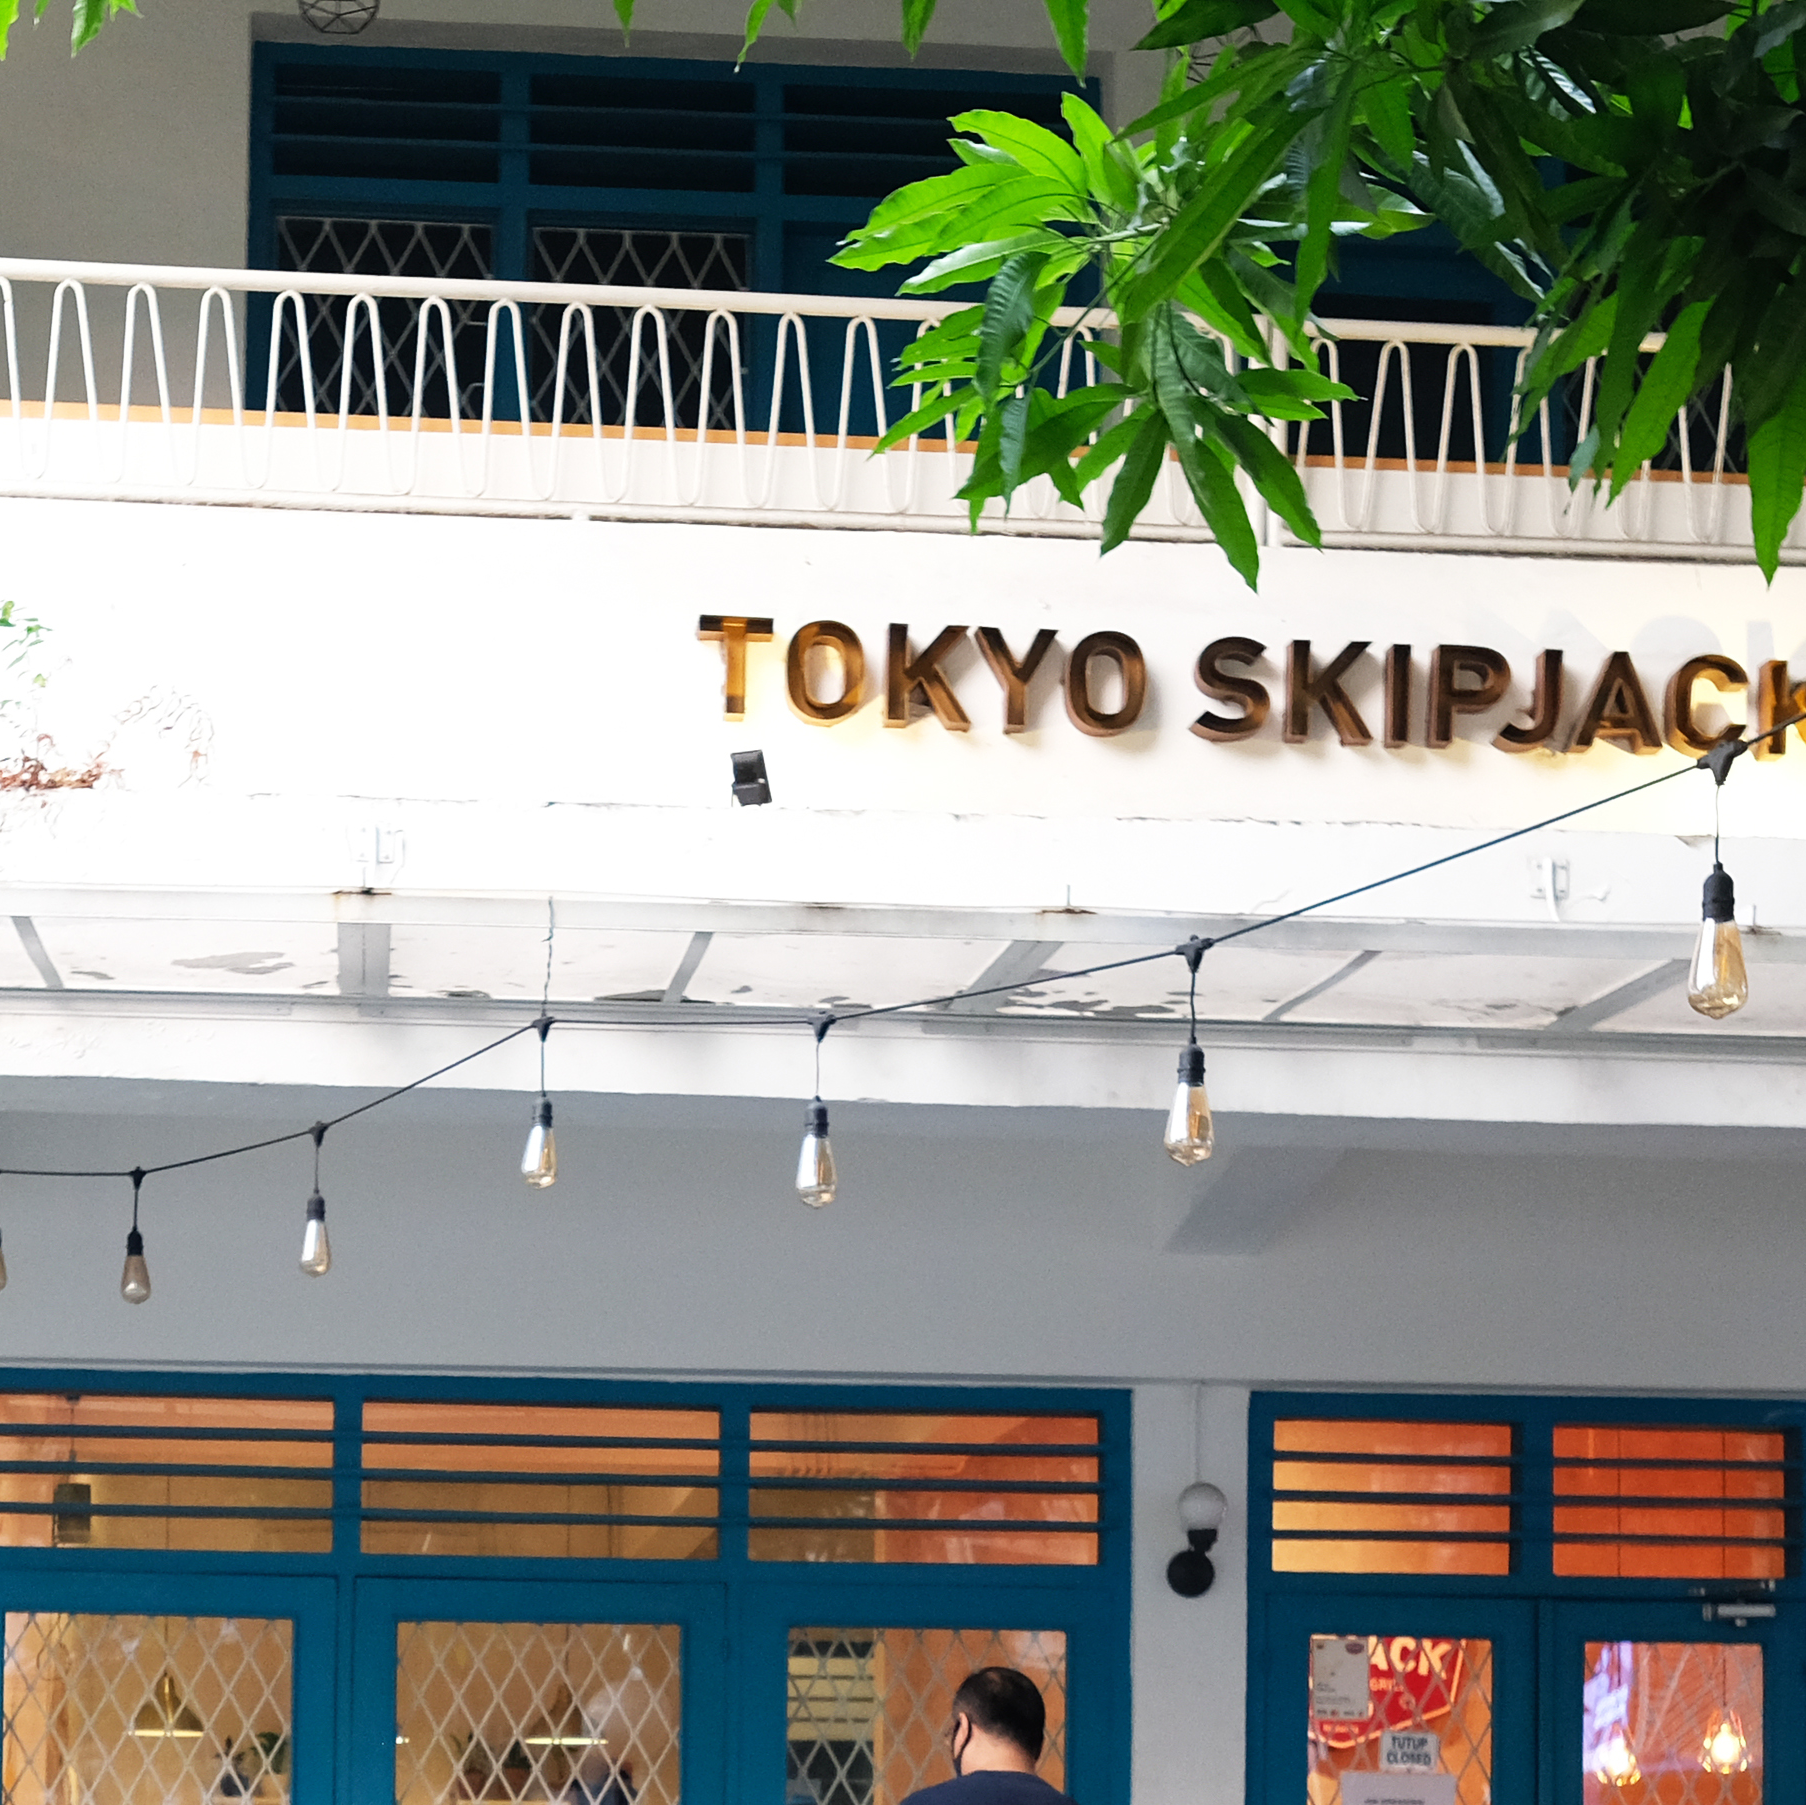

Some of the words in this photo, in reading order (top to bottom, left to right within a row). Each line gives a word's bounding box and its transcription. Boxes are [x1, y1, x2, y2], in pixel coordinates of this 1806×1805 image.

[696, 613, 1148, 737] TOKYO
[1391, 1735, 1429, 1750] TUTUP
[1386, 1751, 1432, 1766] CLOSED
